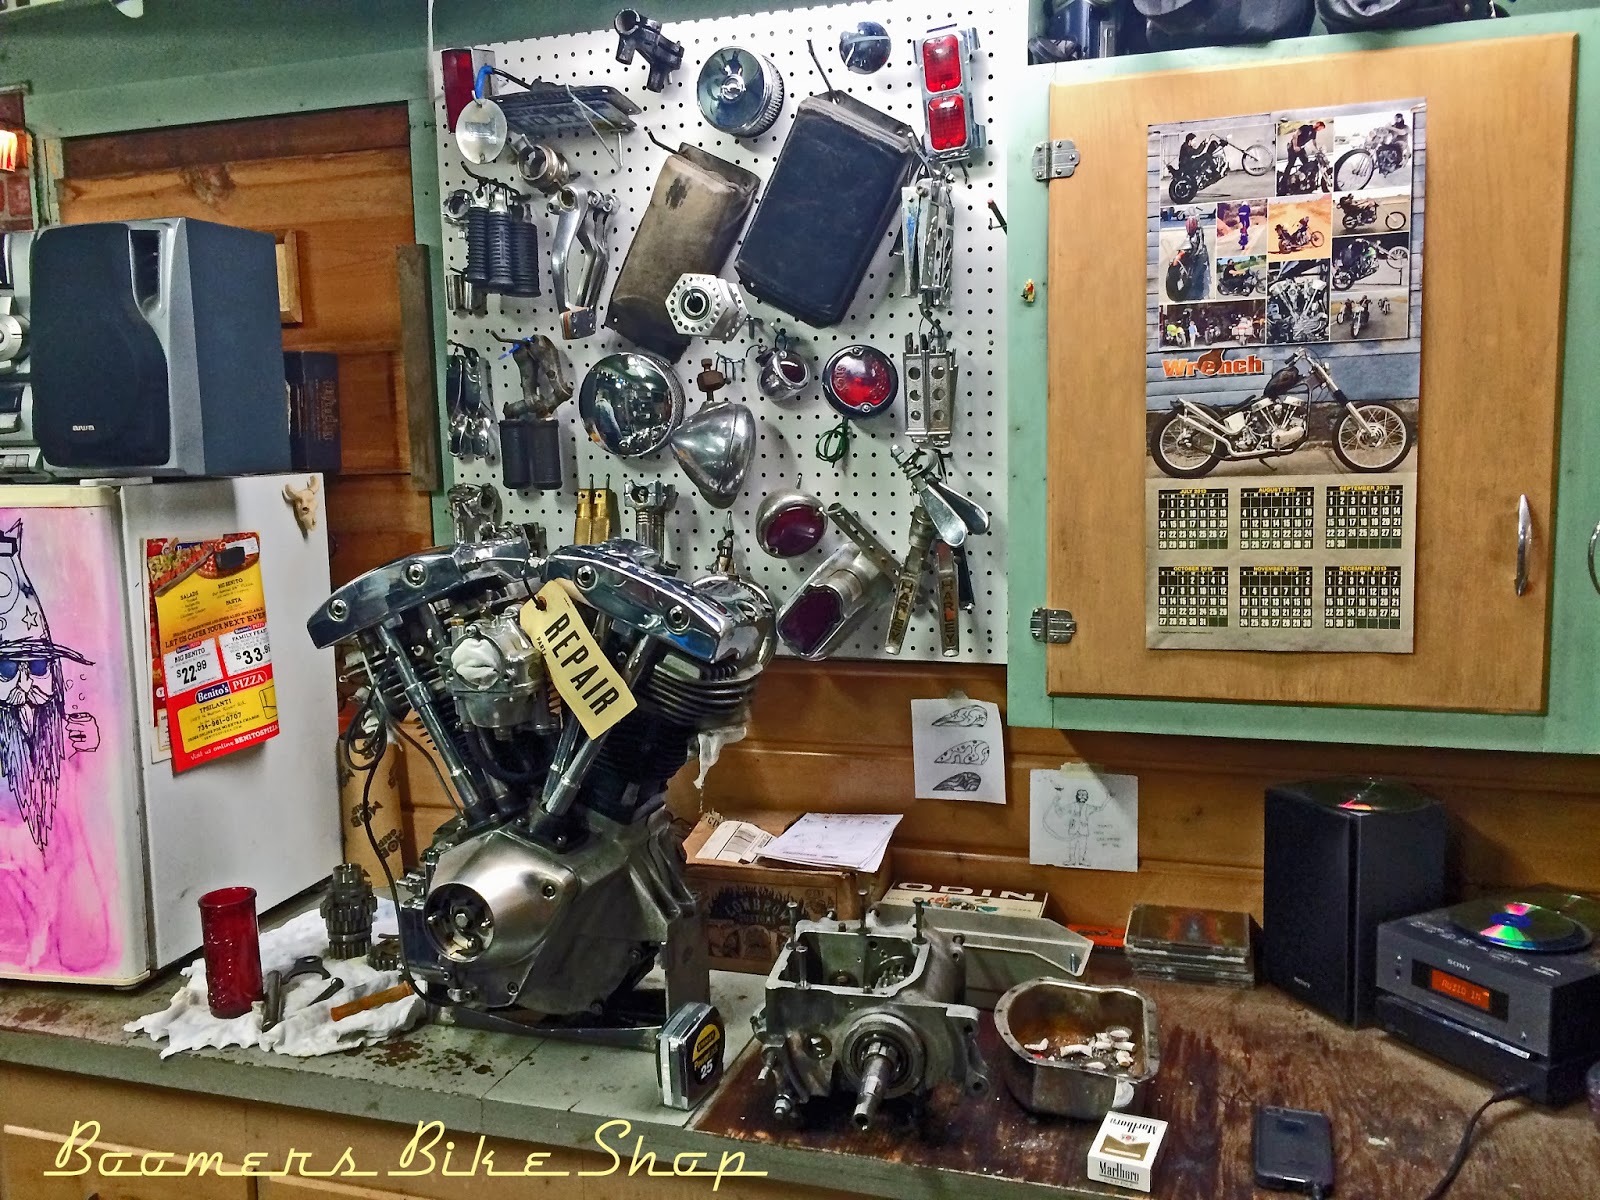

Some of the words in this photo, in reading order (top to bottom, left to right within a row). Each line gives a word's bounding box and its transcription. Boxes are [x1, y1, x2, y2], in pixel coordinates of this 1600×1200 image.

[1162, 354, 1264, 377] Wrench
[1210, 499, 1214, 507] 5
[1295, 497, 1300, 505] 2
[1306, 497, 1311, 506] 3
[1340, 497, 1345, 505] 2
[1351, 496, 1356, 504] 3
[1373, 496, 1378, 504] 5
[1395, 496, 1400, 504] 7
[1242, 509, 1246, 517] 4
[1253, 509, 1257, 517] 5
[1274, 508, 1278, 516] 7
[1371, 507, 1378, 515] 12
[1393, 507, 1400, 515] 14
[1252, 520, 1259, 528] 12
[1273, 519, 1280, 527] 14
[1272, 530, 1280, 538] 21
[1306, 577, 1310, 585] 2
[1338, 576, 1343, 584] 2
[1350, 576, 1354, 585] 3
[1370, 576, 1375, 585] 5
[1393, 577, 1398, 585] 7
[180, 590, 199, 600] SALADS
[1220, 587, 1227, 595] 12
[1242, 587, 1246, 595] 3
[1263, 587, 1267, 595] 5
[1284, 587, 1288, 595] 7
[1370, 587, 1377, 596] 12
[226, 597, 242, 606] PASTA
[1348, 598, 1355, 606] 17
[1392, 598, 1399, 606] 21
[891, 581, 914, 641] HARLEY
[942, 580, 955, 644] HARLEY
[1380, 609, 1388, 617] 27
[165, 638, 178, 648] LET
[188, 629, 206, 640] CATER
[207, 623, 224, 634] YOUR
[224, 617, 245, 628] NEXT
[232, 632, 252, 641] FAMILY
[184, 648, 206, 660] BENITO
[544, 612, 620, 716] REPAIR
[176, 660, 207, 684] $22.99
[198, 684, 229, 702] Benito's
[232, 674, 264, 690] PIZZA
[199, 698, 232, 713] YPSILANTI
[213, 741, 234, 752] online
[898, 882, 1035, 900] ODIN
[1447, 958, 1471, 972] SONY
[700, 1060, 713, 1079] 25
[1110, 1118, 1157, 1135] Marlboro
[1099, 1161, 1139, 1182] Marlboro
